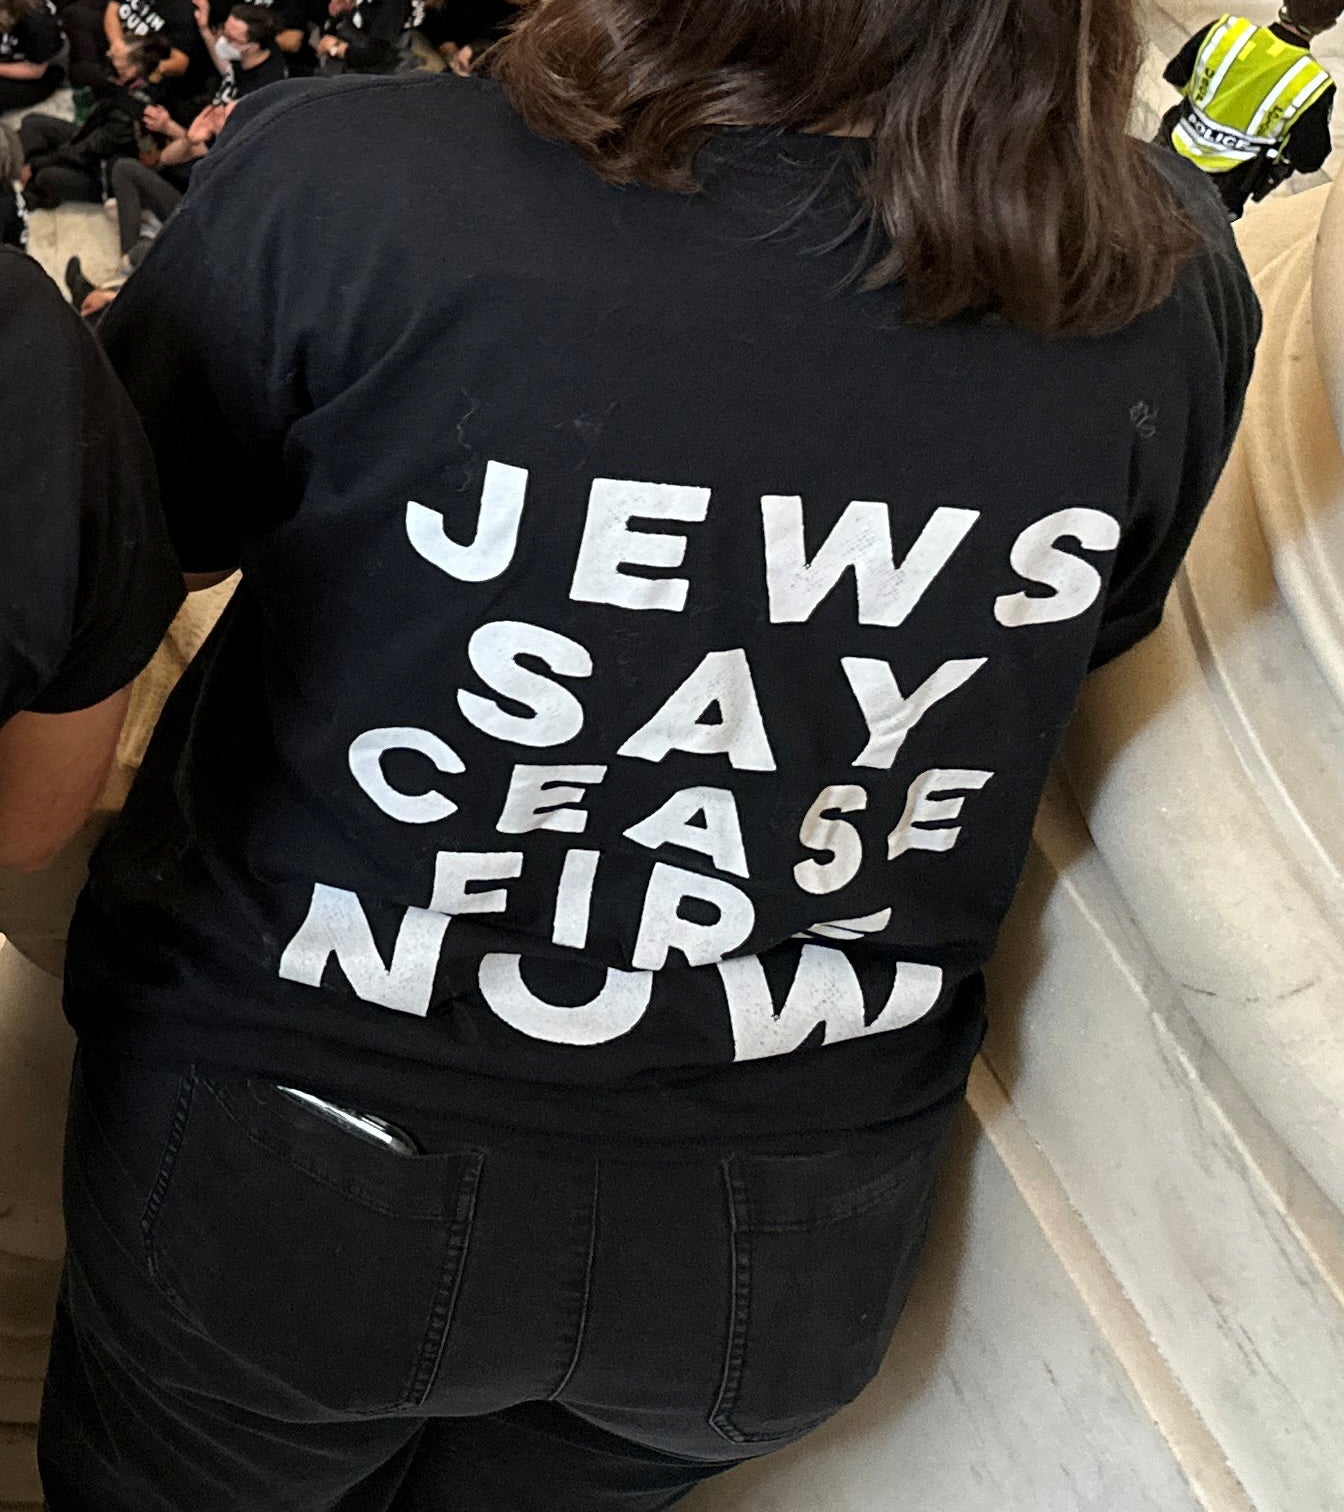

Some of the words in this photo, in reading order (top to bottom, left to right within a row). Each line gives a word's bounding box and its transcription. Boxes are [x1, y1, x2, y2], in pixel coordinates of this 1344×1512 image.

[119, 3, 150, 37] OUR
[144, 12, 166, 33] IN
[1186, 113, 1251, 152] POLICE
[406, 459, 1122, 628] JEWS
[456, 620, 988, 772] SAY
[347, 726, 994, 895] CEASE
[278, 881, 944, 1064] NOW
